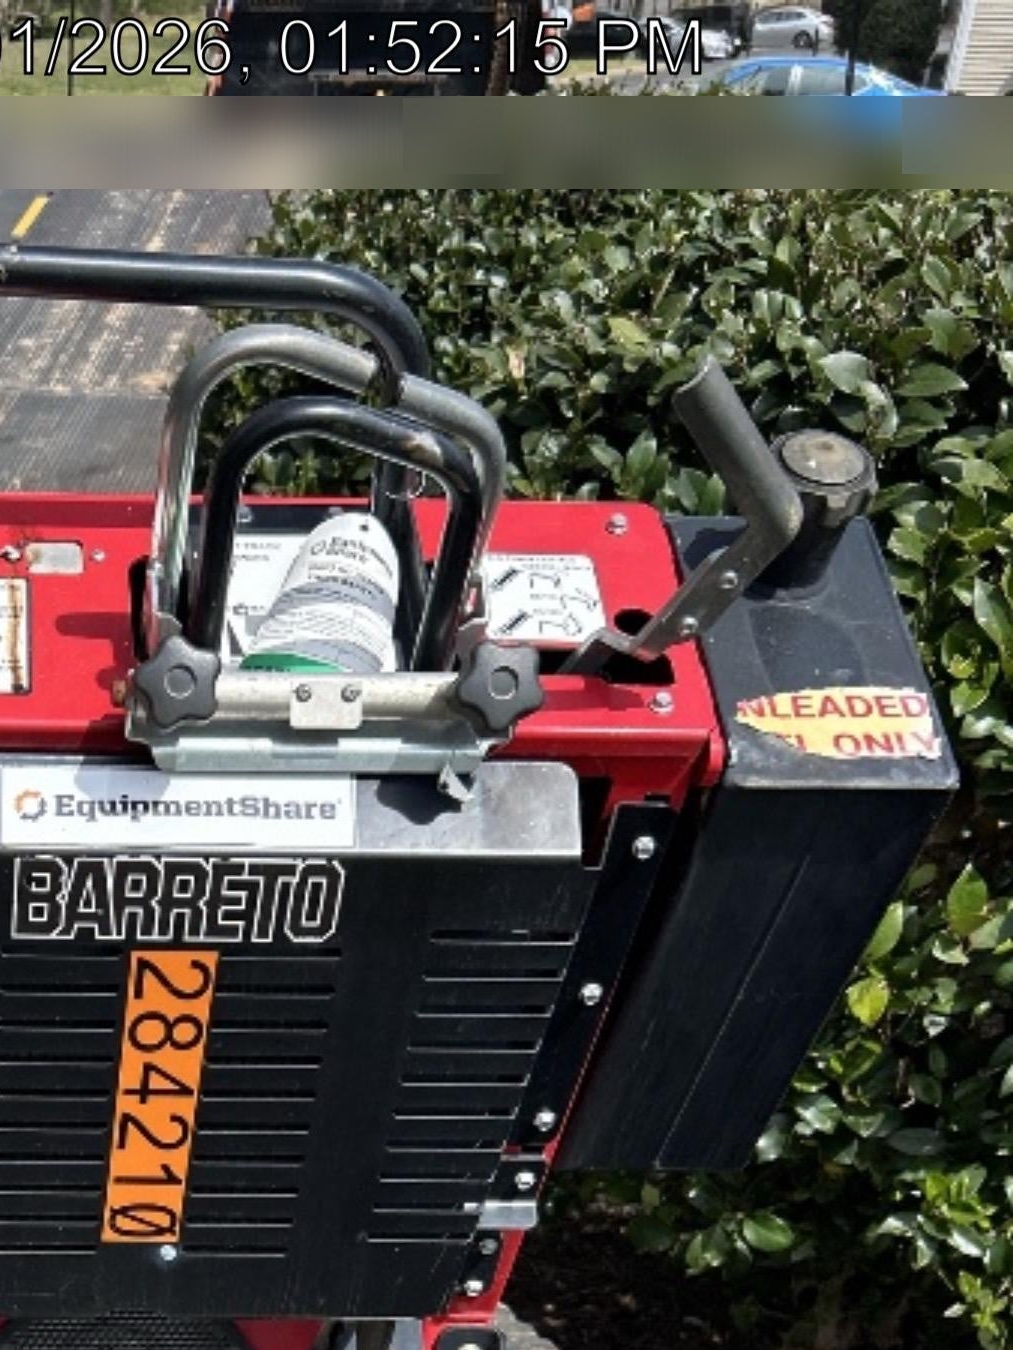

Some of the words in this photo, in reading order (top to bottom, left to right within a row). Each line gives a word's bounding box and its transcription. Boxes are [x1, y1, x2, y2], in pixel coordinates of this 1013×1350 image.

[737, 694, 930, 719] NLEADED
[832, 731, 936, 755] ONLY
[54, 794, 337, 822] EquipmentShare
[10, 855, 345, 943] BARRETO
[108, 956, 212, 1238] 284210
